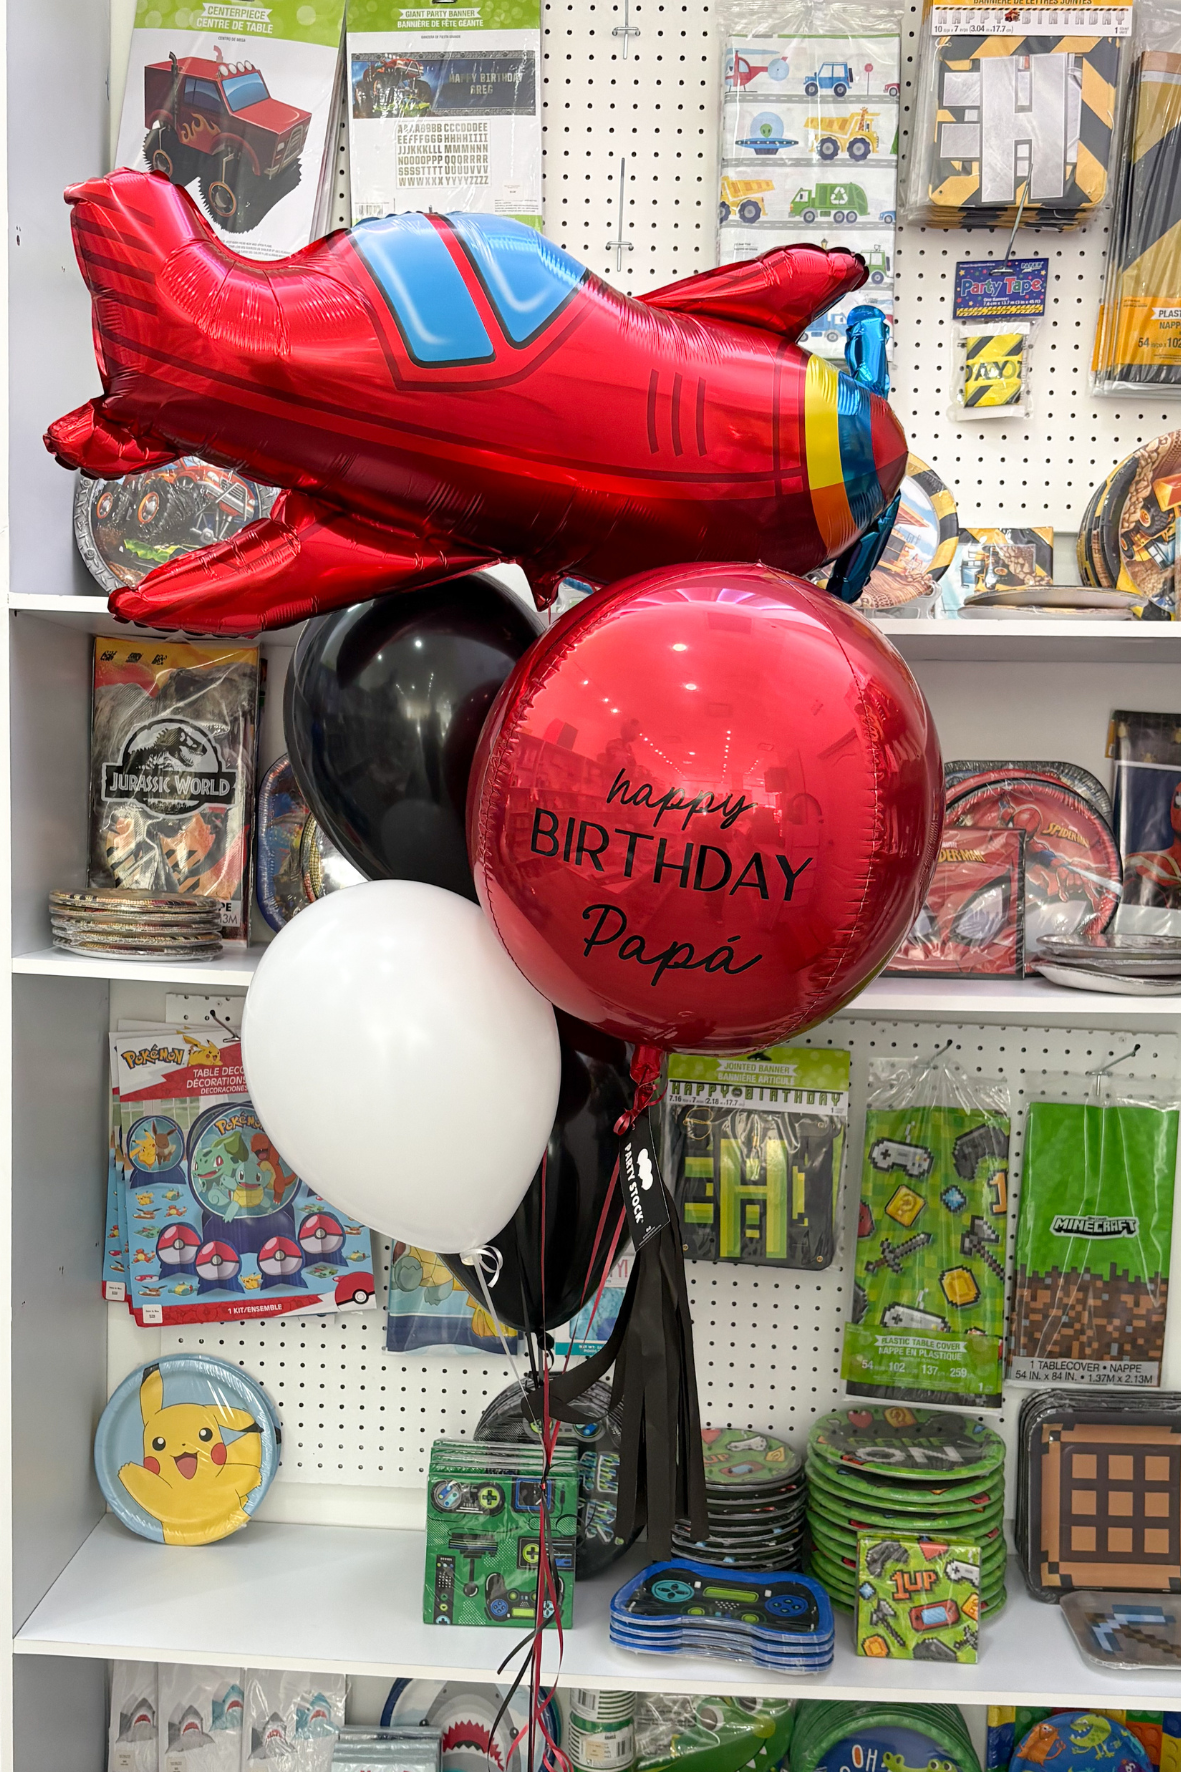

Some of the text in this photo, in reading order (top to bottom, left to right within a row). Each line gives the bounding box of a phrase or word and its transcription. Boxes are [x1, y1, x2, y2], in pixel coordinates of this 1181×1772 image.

[208, 6, 266, 20] CENTERPIECE
[938, 11, 1124, 25] HAPPY BIRTHDAY
[197, 18, 273, 33] CENTRE DE TABLE
[398, 20, 429, 28] BANNIÈRE
[442, 19, 457, 27] FÊTE
[480, 73, 523, 83] BIRTHDAY
[961, 277, 1042, 296] Party Tape
[1138, 337, 1149, 347] 54
[110, 772, 230, 796] JURASSIC WORLD
[607, 768, 758, 830] happy
[530, 808, 813, 901] BIRTHDAY
[582, 904, 762, 986] Papá
[193, 1068, 219, 1078] TABLE
[724, 1062, 790, 1074] JOINTED BANNER
[187, 1076, 246, 1088] DÉCORATIONS
[672, 1082, 840, 1106] HAPPY BIRTHDAY
[624, 1142, 644, 1224] PARTY STOCK
[1054, 1217, 1136, 1235] MINECRAFT
[233, 1304, 282, 1314] KIT/ENSEMBLE
[912, 1339, 934, 1348] TABLE
[936, 1342, 960, 1350] COVER
[879, 1347, 904, 1355] NAPPE
[906, 1348, 916, 1356] EN
[919, 1350, 962, 1361] PLASTIQUE
[862, 1360, 967, 1378] 54 102 137 259
[1030, 1361, 1142, 1373] 1 TABLECOVER NAPPE
[1015, 1370, 1026, 1379] 54
[1029, 1371, 1041, 1380] IN.
[1052, 1372, 1063, 1380] 84
[1065, 1373, 1077, 1381] IN.
[1089, 1374, 1115, 1382] 1.37M
[1125, 1375, 1152, 1384] 2.13M
[979, 1383, 983, 1392] 1
[847, 1437, 950, 1446] GAME
[703, 1453, 729, 1464] UP
[855, 1446, 964, 1462] ON
[891, 1570, 938, 1600] 1UP
